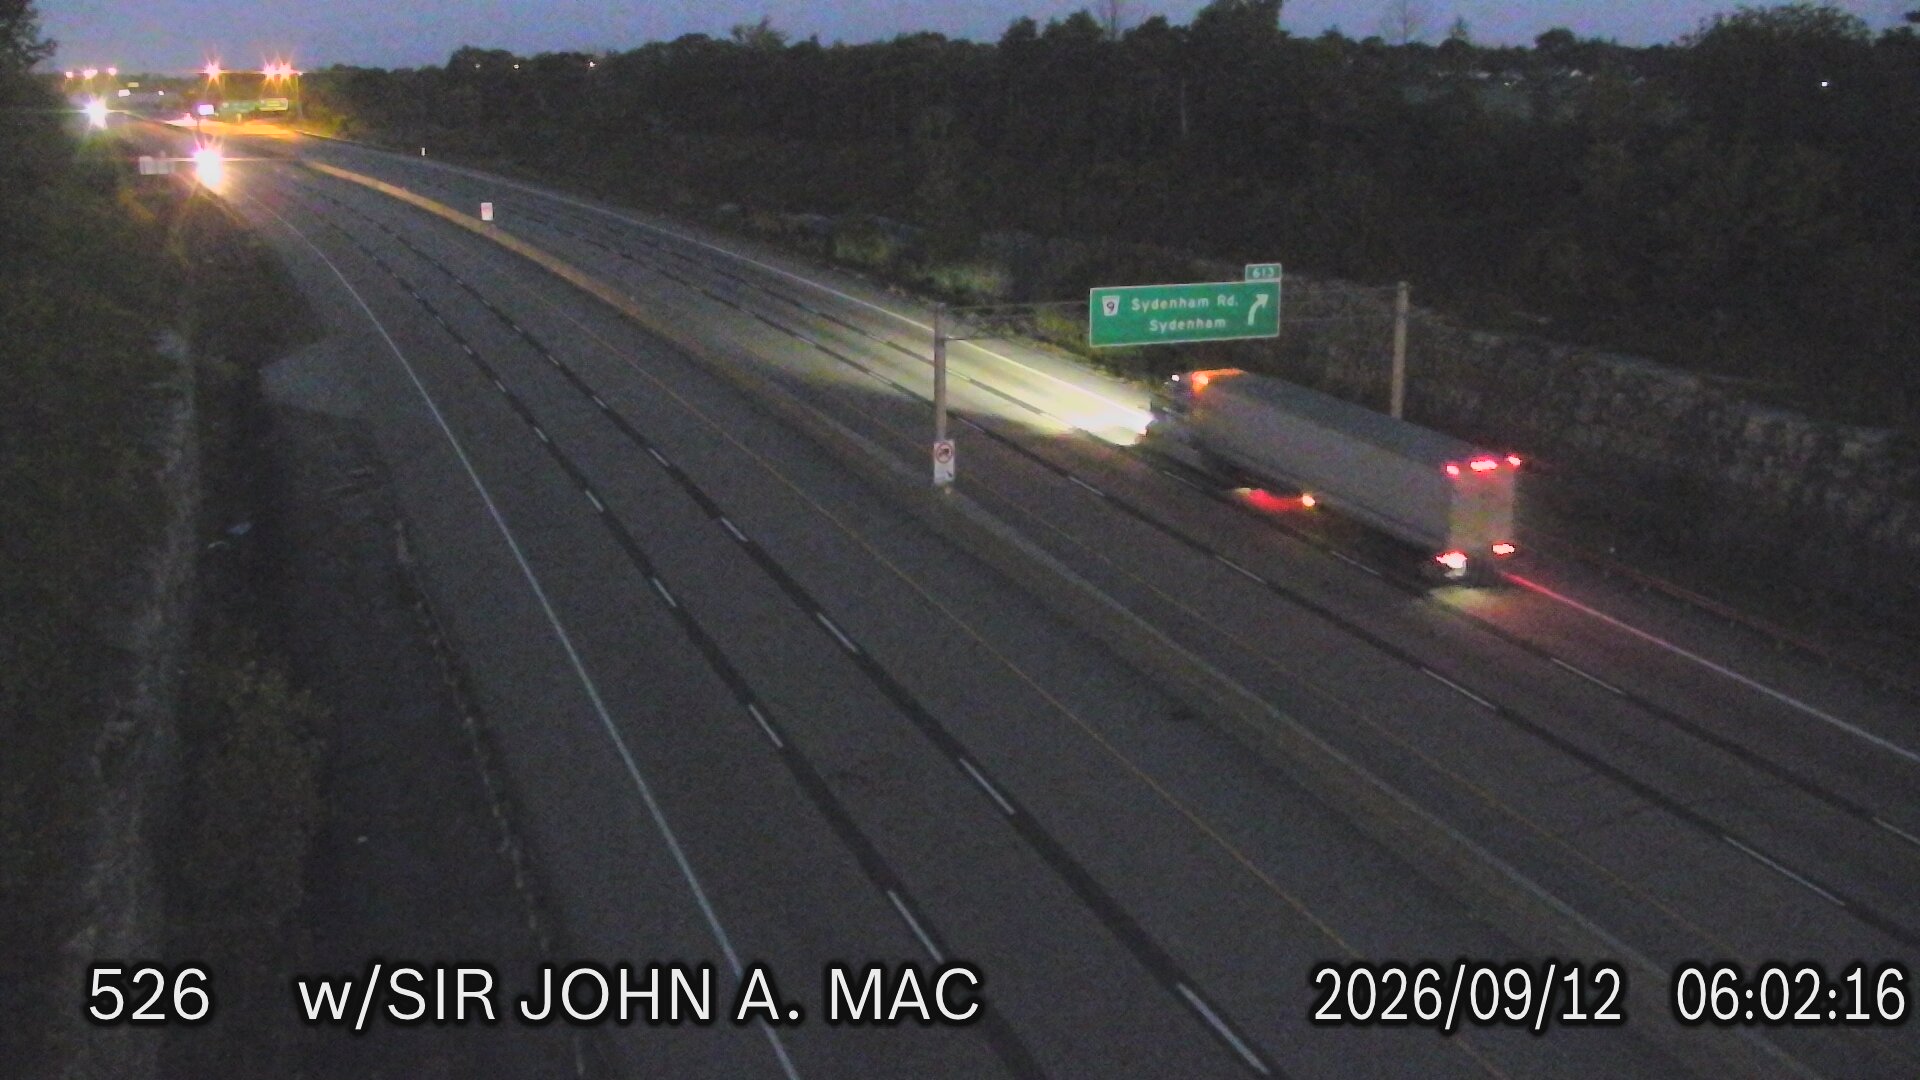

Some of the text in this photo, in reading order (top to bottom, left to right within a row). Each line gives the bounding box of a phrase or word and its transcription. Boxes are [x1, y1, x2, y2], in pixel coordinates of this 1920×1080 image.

[1252, 267, 1275, 278] 613
[1106, 301, 1115, 312] 9
[1131, 294, 1238, 313] Sydenham Rd.
[1149, 318, 1226, 334] Sydenham
